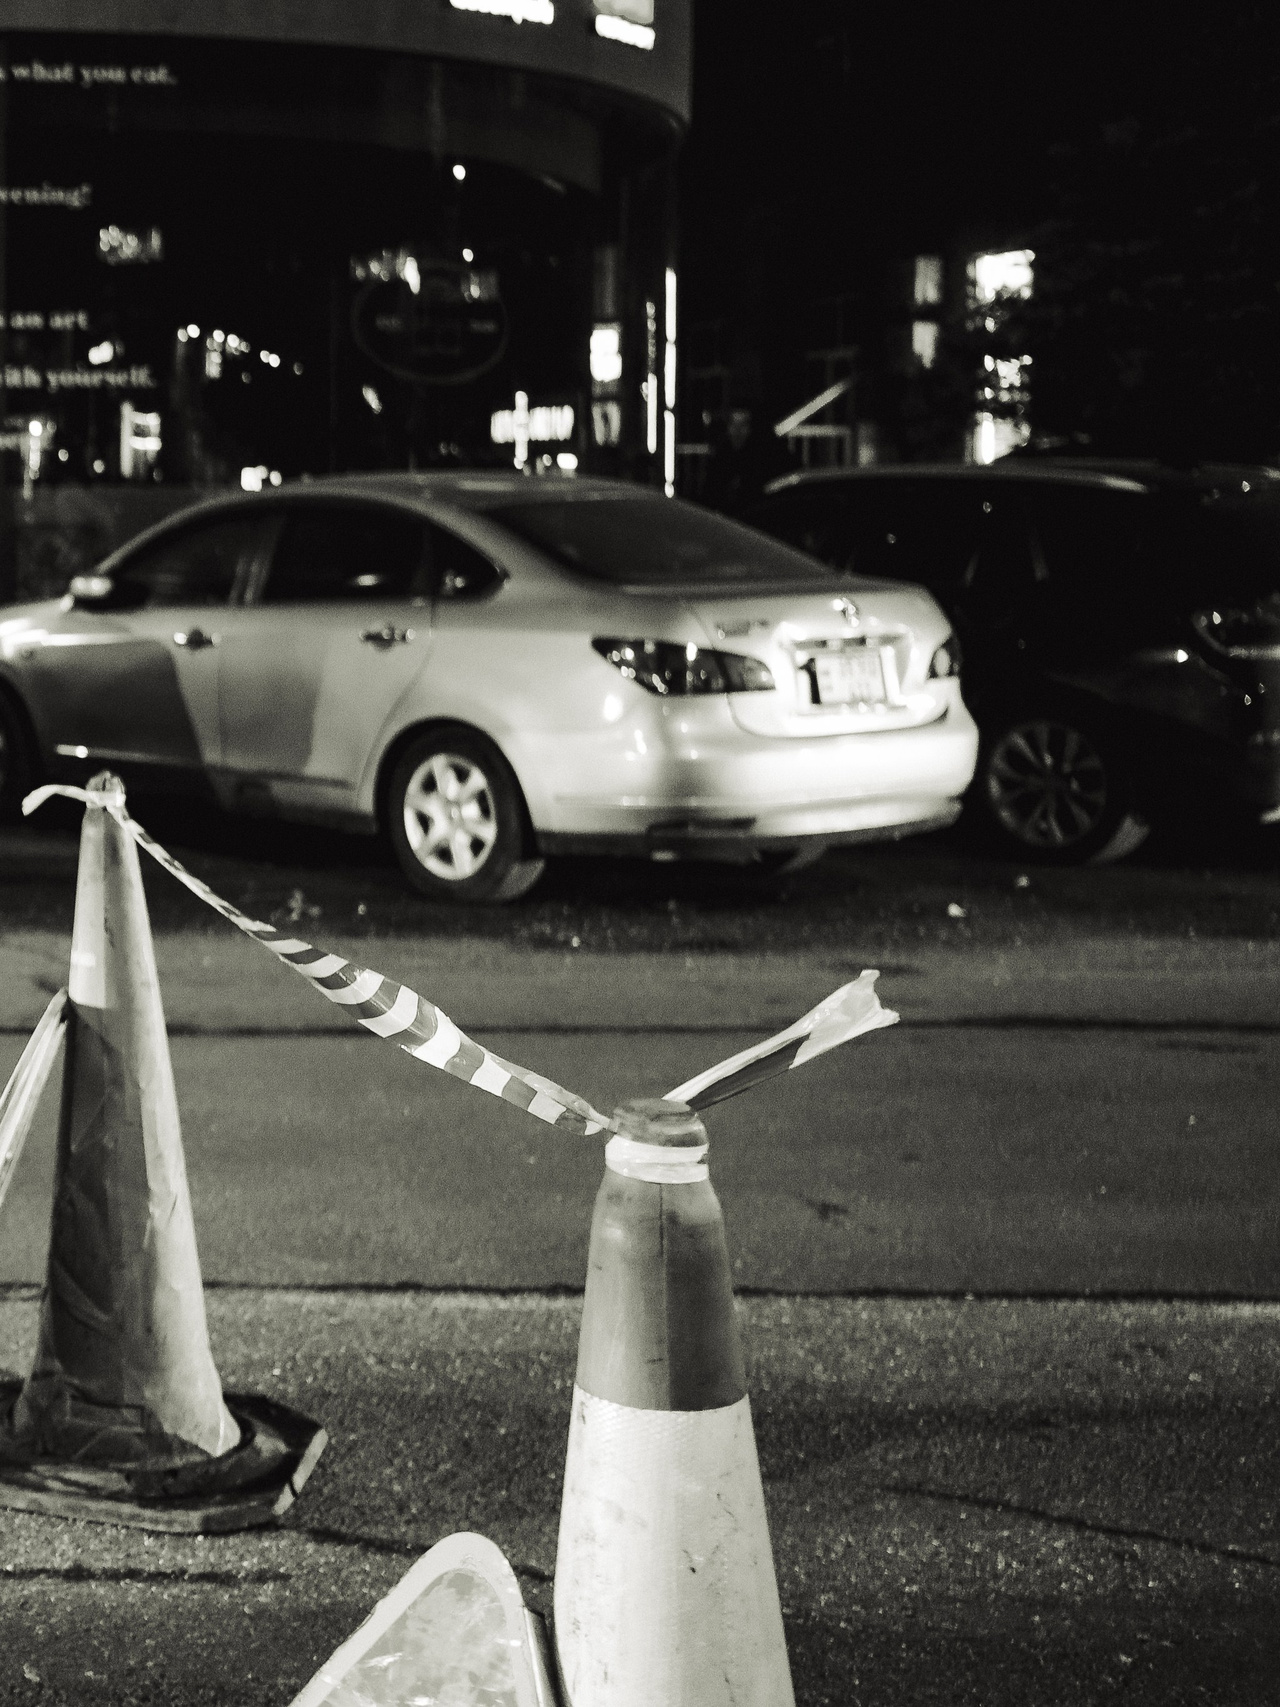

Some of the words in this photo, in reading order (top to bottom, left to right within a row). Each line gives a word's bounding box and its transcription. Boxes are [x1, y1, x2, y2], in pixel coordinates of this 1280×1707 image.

[11, 61, 75, 83] what
[79, 64, 128, 89] you
[10, 309, 45, 330] an
[48, 309, 90, 331] art
